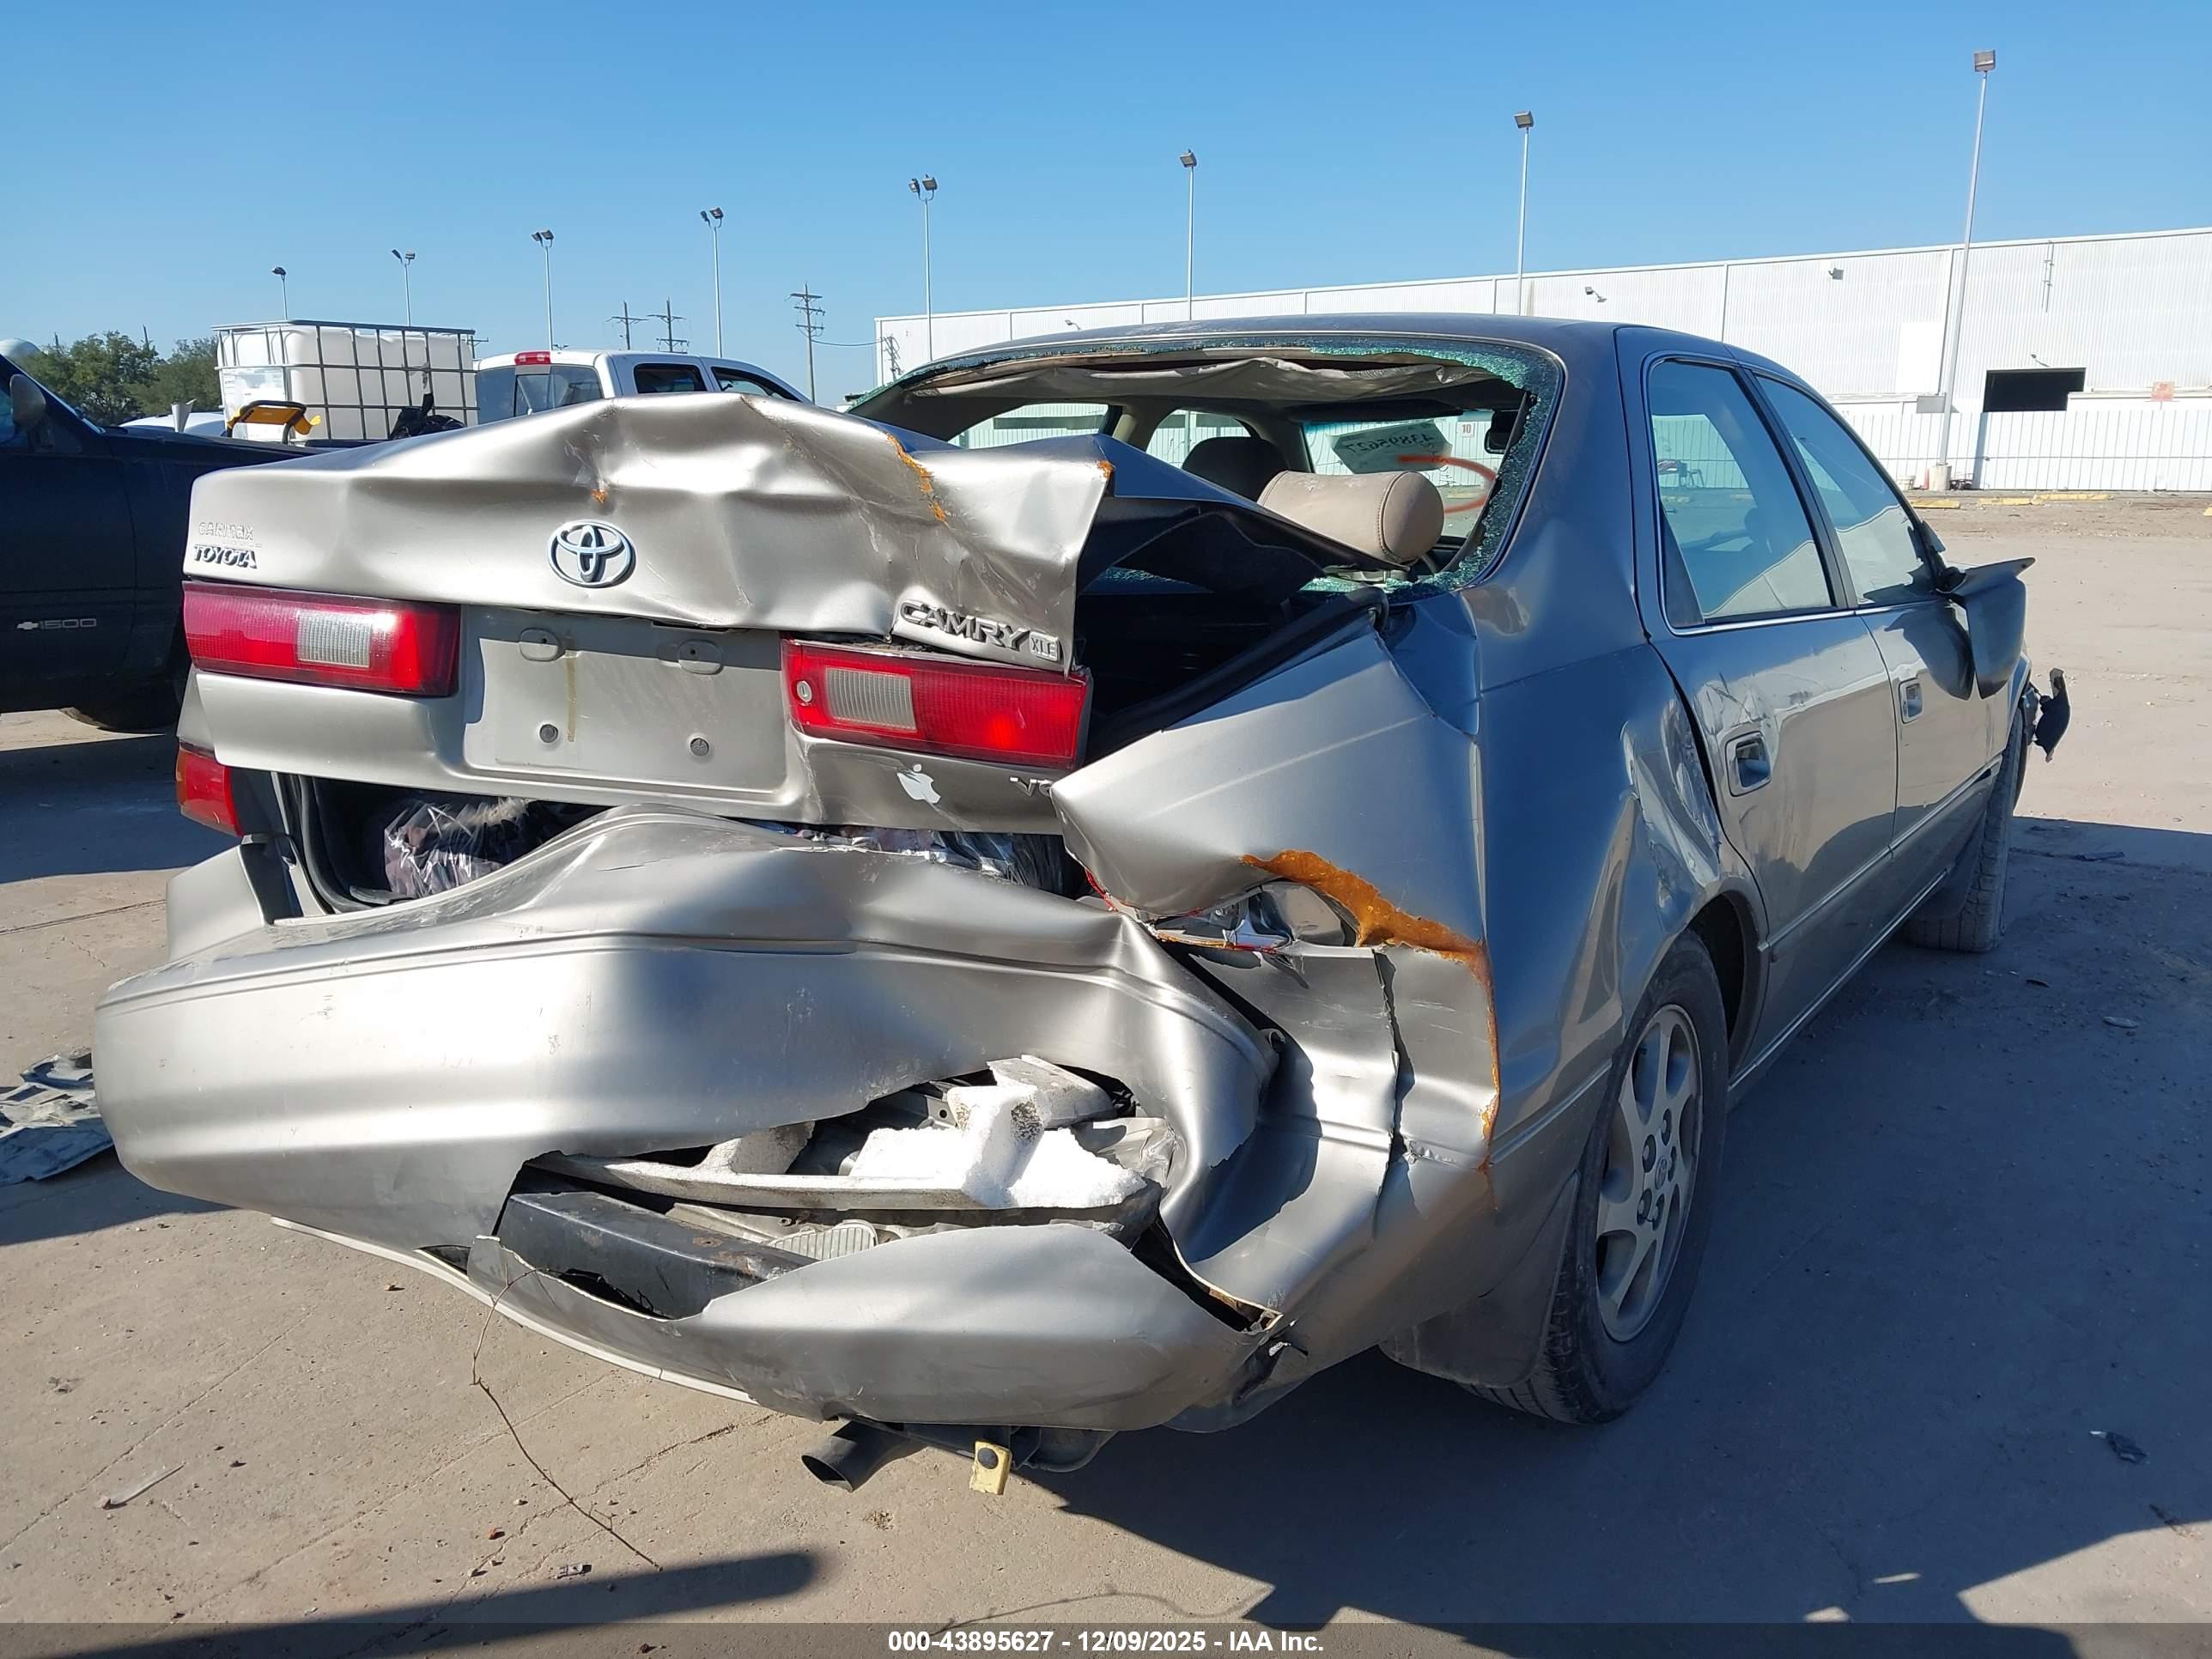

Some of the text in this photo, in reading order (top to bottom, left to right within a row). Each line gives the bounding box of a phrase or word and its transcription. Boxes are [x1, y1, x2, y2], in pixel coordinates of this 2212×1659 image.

[1462, 423, 1472, 434] 10
[194, 544, 258, 568] TOYOTA
[40, 618, 97, 630] 1500
[900, 600, 1059, 661] CAMRY XLE
